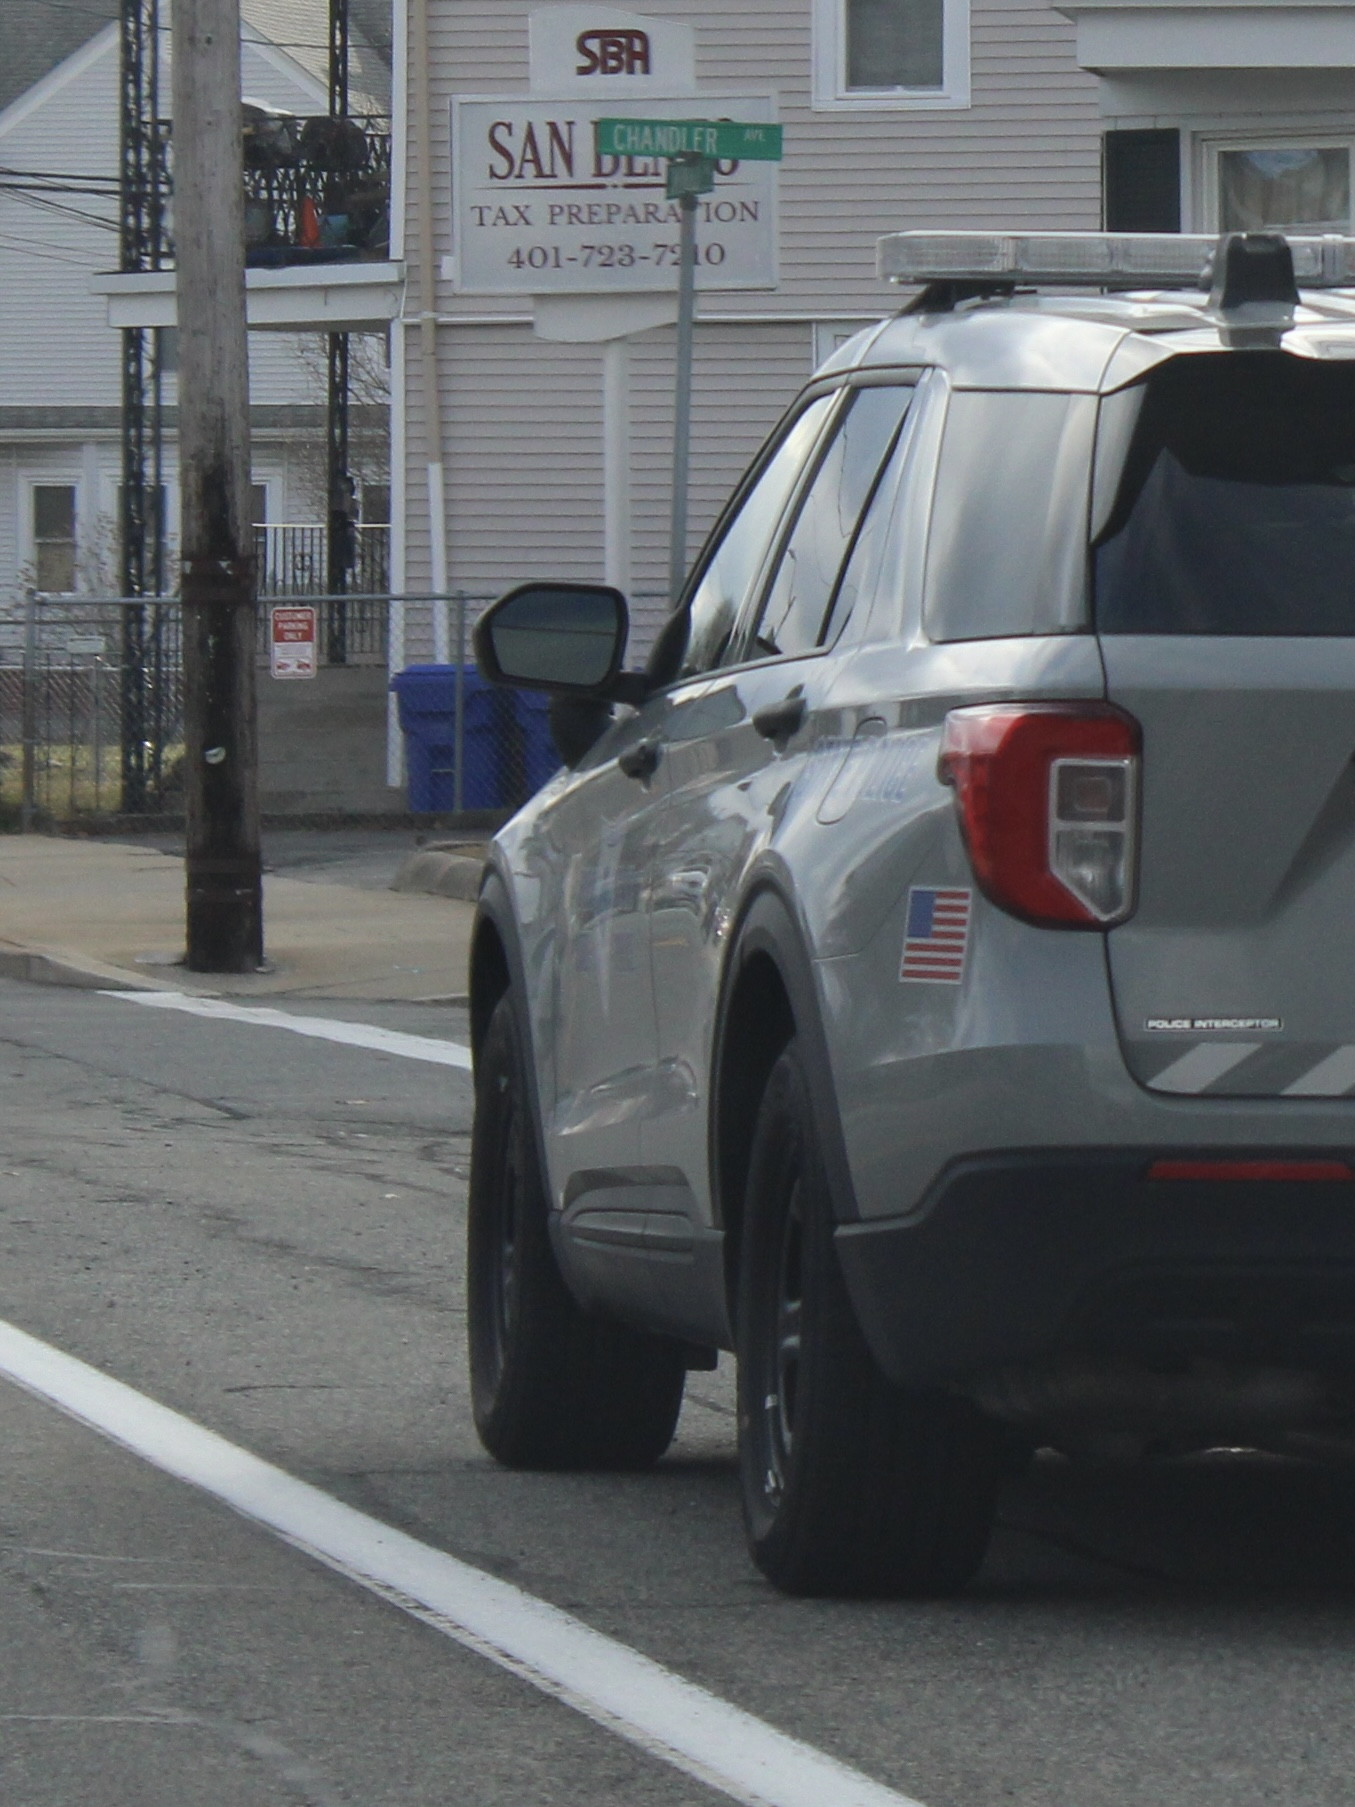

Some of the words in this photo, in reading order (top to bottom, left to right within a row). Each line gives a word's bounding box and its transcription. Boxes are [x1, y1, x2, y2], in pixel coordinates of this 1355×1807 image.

[488, 120, 577, 180] SAN
[612, 124, 718, 153] CHANDLER
[470, 205, 533, 226] TAX
[549, 200, 760, 226] PREPARAION
[1148, 1018, 1190, 1029] POLICE
[1193, 1018, 1279, 1029] INTERCEPTOR
